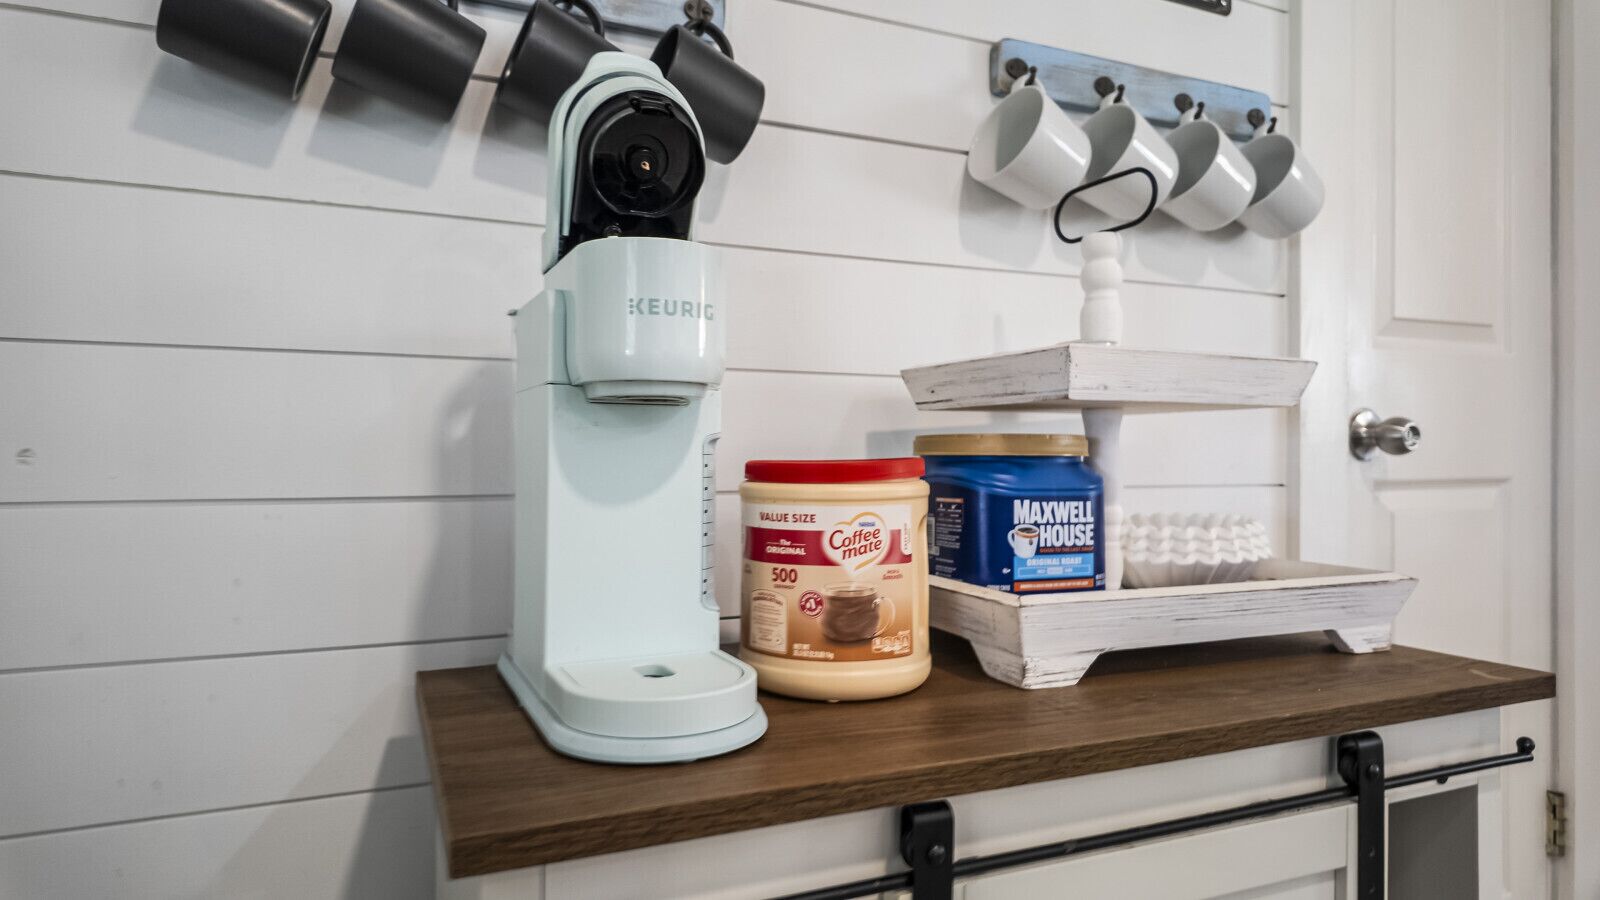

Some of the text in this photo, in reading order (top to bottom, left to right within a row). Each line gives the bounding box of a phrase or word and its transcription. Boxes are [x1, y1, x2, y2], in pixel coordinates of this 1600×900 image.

[628, 297, 714, 320] KEURIG
[759, 511, 816, 523] VALUE SIZE
[1013, 499, 1094, 524] MAXWELL
[829, 528, 880, 549] Coffee
[1040, 524, 1094, 547] HOUSE
[766, 546, 806, 555] ORIGINAL
[842, 540, 882, 560] mate
[1026, 557, 1082, 566] ORIGINAL ROAST
[772, 567, 798, 583] 500
